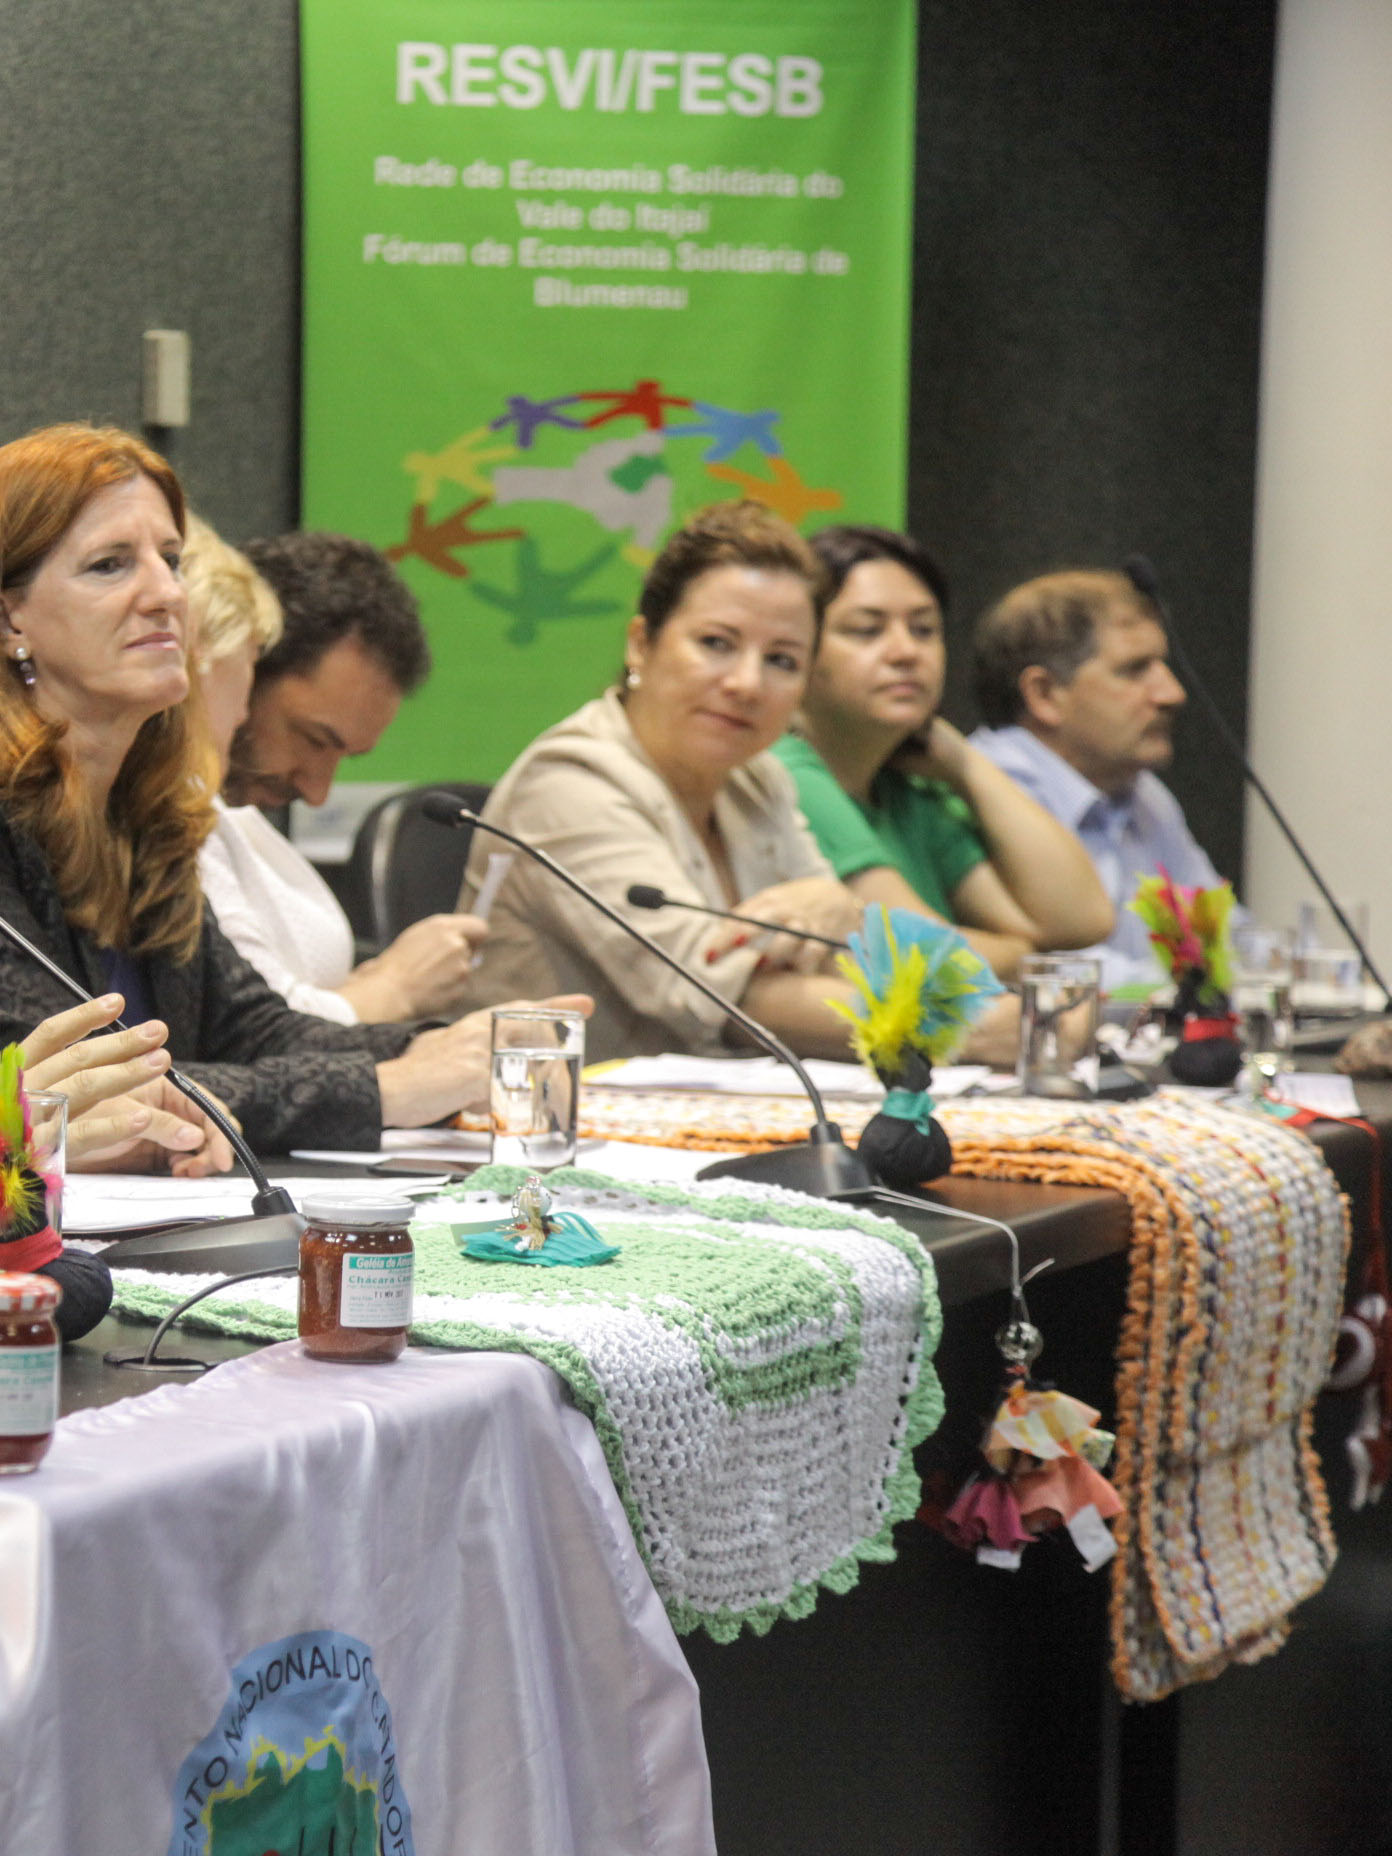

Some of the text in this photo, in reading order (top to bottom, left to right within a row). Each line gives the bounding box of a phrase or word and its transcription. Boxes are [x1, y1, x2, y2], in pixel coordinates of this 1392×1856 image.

[374, 155, 457, 188] Rede
[462, 158, 504, 189] de
[509, 159, 662, 194] Economia
[516, 199, 584, 230] Vale
[588, 200, 632, 231] do
[363, 233, 467, 265] Fórum
[471, 236, 513, 267] de
[518, 236, 672, 271] Economia
[534, 276, 688, 309] Blumenau
